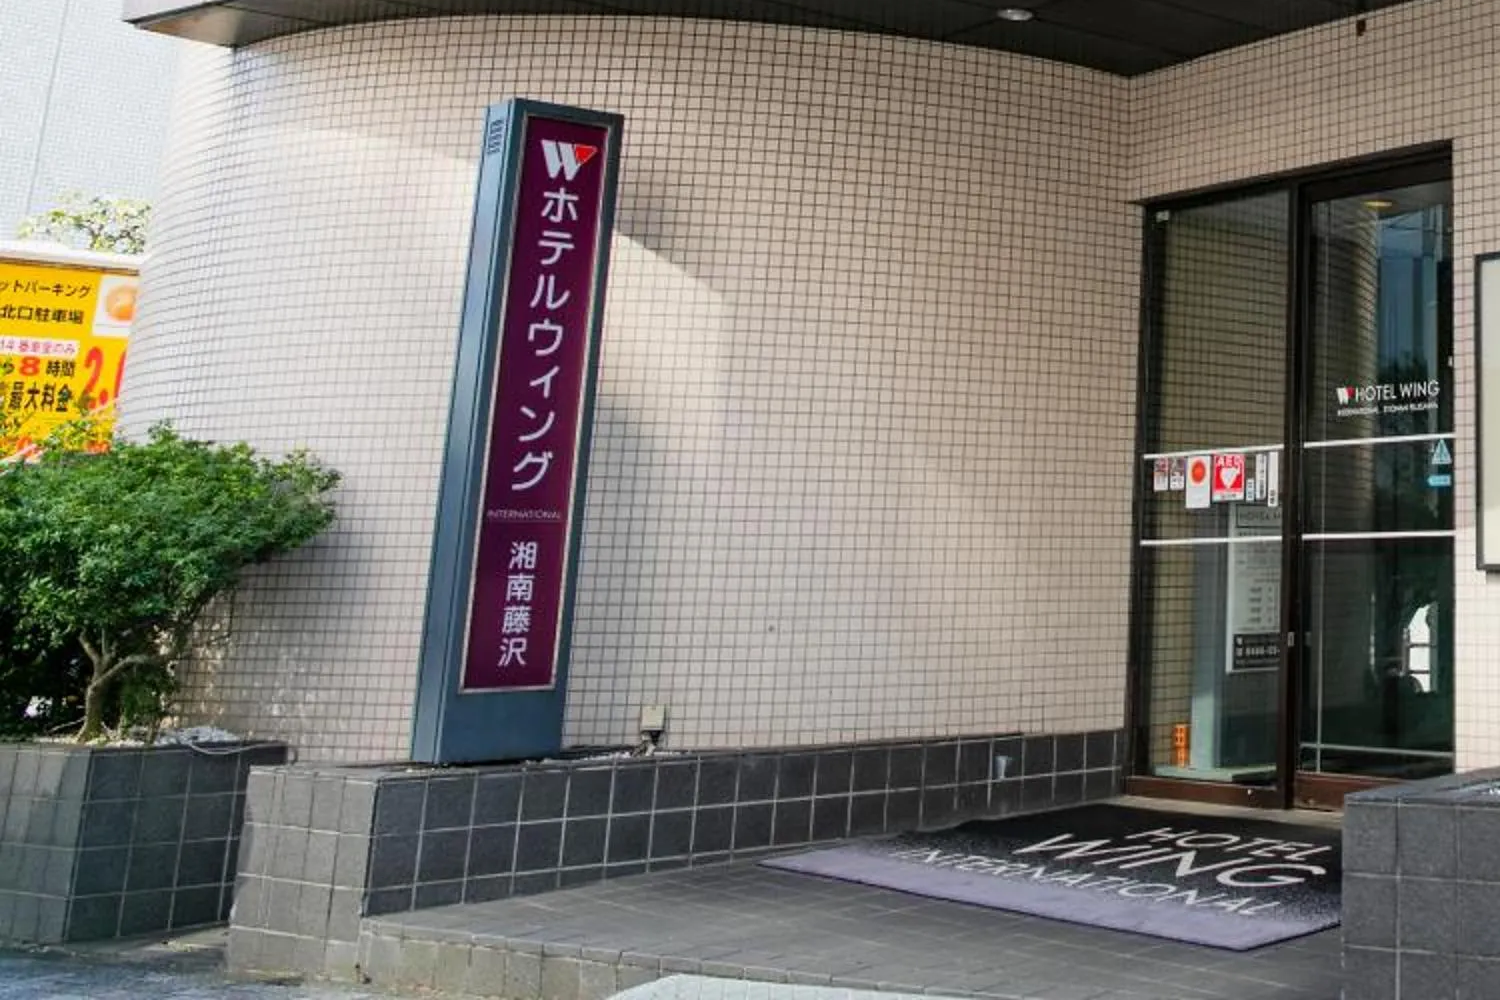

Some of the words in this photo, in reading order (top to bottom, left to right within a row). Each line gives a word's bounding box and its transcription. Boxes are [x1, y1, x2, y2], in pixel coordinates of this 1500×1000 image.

[511, 187, 579, 491] ホテルウィング
[1355, 384, 1398, 403] HOTEL
[1399, 379, 1441, 399] WING
[497, 540, 539, 667] 湘南藤沢
[1011, 833, 1328, 888] WING
[1124, 827, 1332, 862] HOTEL
[893, 847, 1281, 916] INTERNATIONAL
